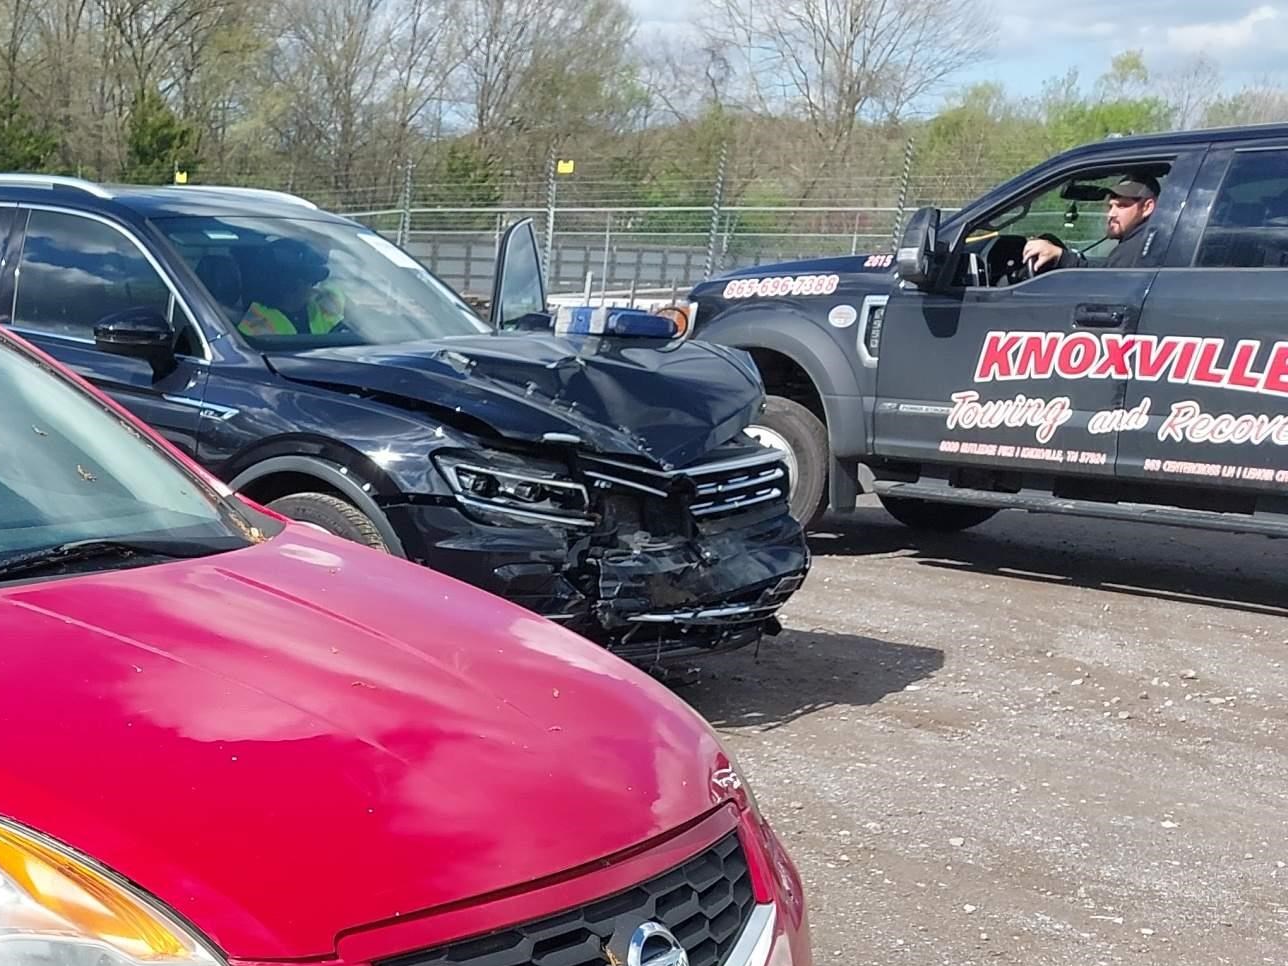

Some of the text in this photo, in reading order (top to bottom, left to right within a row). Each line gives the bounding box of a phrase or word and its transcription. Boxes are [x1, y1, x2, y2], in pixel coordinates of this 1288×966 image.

[973, 332, 1288, 397] KNOXVILLE
[947, 390, 1073, 443] Towing
[1089, 397, 1151, 434] and
